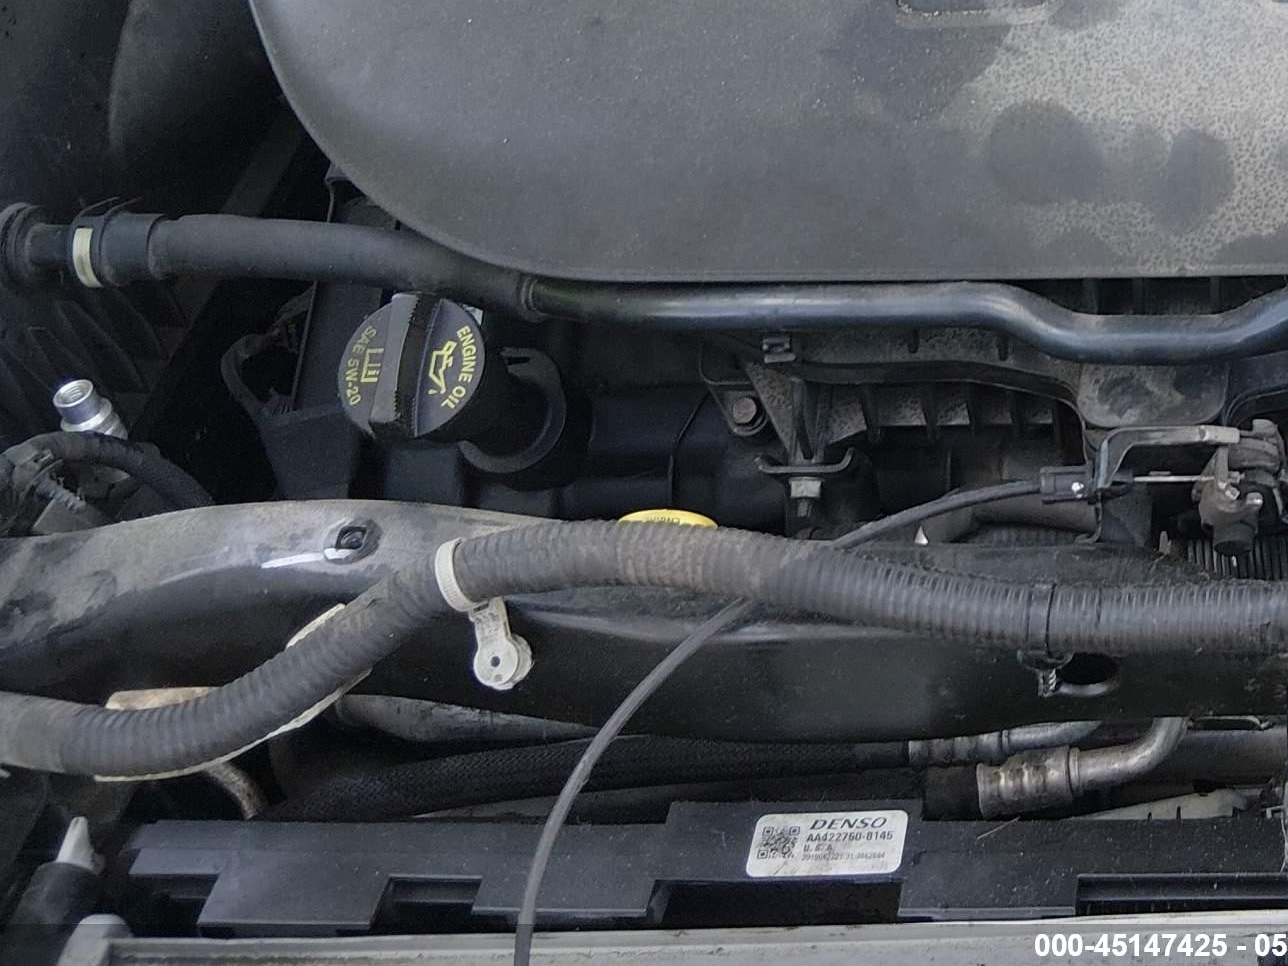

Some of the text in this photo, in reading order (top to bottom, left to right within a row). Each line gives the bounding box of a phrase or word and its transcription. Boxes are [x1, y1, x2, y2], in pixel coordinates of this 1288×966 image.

[345, 325, 377, 406] SAE 5W-20
[440, 324, 477, 409] ENGINE OIL
[809, 817, 888, 830] DENSO
